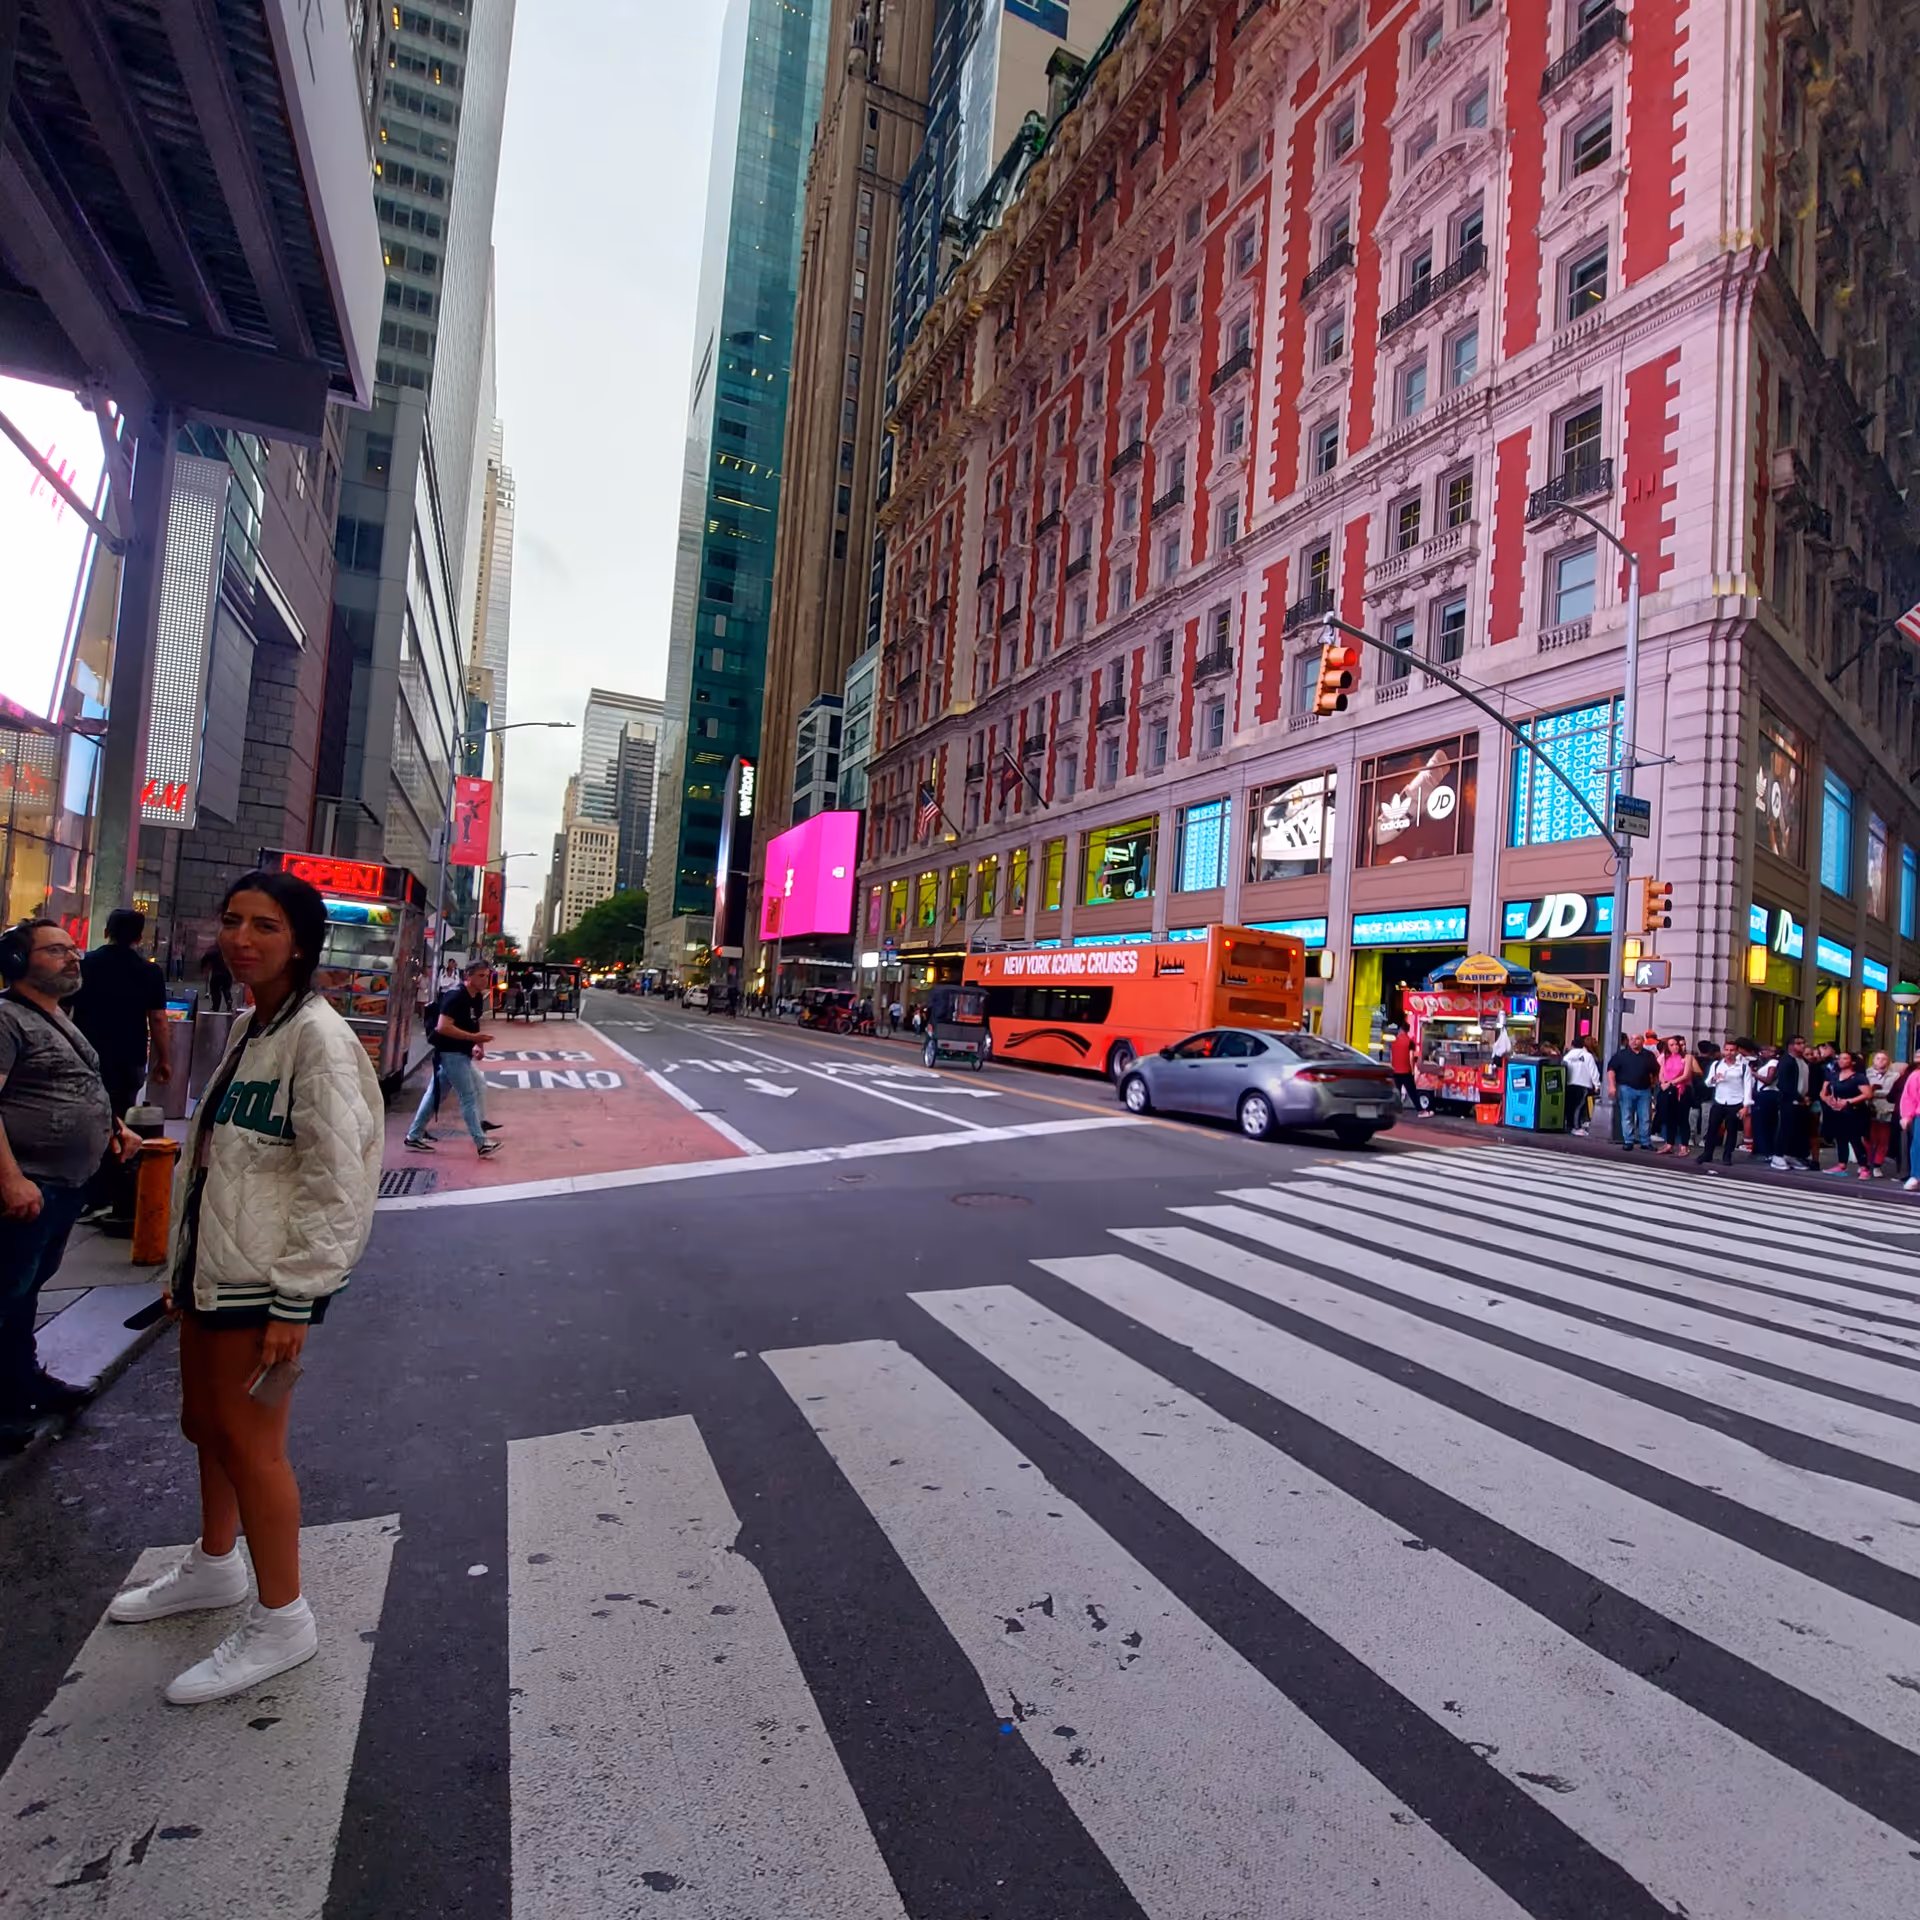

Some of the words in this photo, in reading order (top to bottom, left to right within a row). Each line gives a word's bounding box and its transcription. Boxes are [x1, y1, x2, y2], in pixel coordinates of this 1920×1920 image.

[1556, 738, 1573, 751] OF
[739, 766, 754, 817] verizon
[1432, 794, 1450, 811] JD
[1554, 794, 1570, 807] OF
[1553, 805, 1570, 818] OF
[1380, 818, 1410, 831] adidas
[1552, 817, 1569, 830] OF
[1551, 828, 1568, 841] OF
[292, 861, 374, 890] OPEN
[1506, 912, 1525, 926] OF
[1525, 893, 1588, 940] JD
[1384, 919, 1430, 933] CLASSICS
[1774, 908, 1793, 954] JD
[1003, 956, 1025, 975] NEW
[1026, 954, 1052, 975] YORK
[1051, 952, 1087, 975] ICONIC
[1087, 950, 1138, 974] CRUISES
[1540, 991, 1583, 1000] SABRETT
[482, 1050, 596, 1062] BUS
[480, 1069, 623, 1089] ONLY
